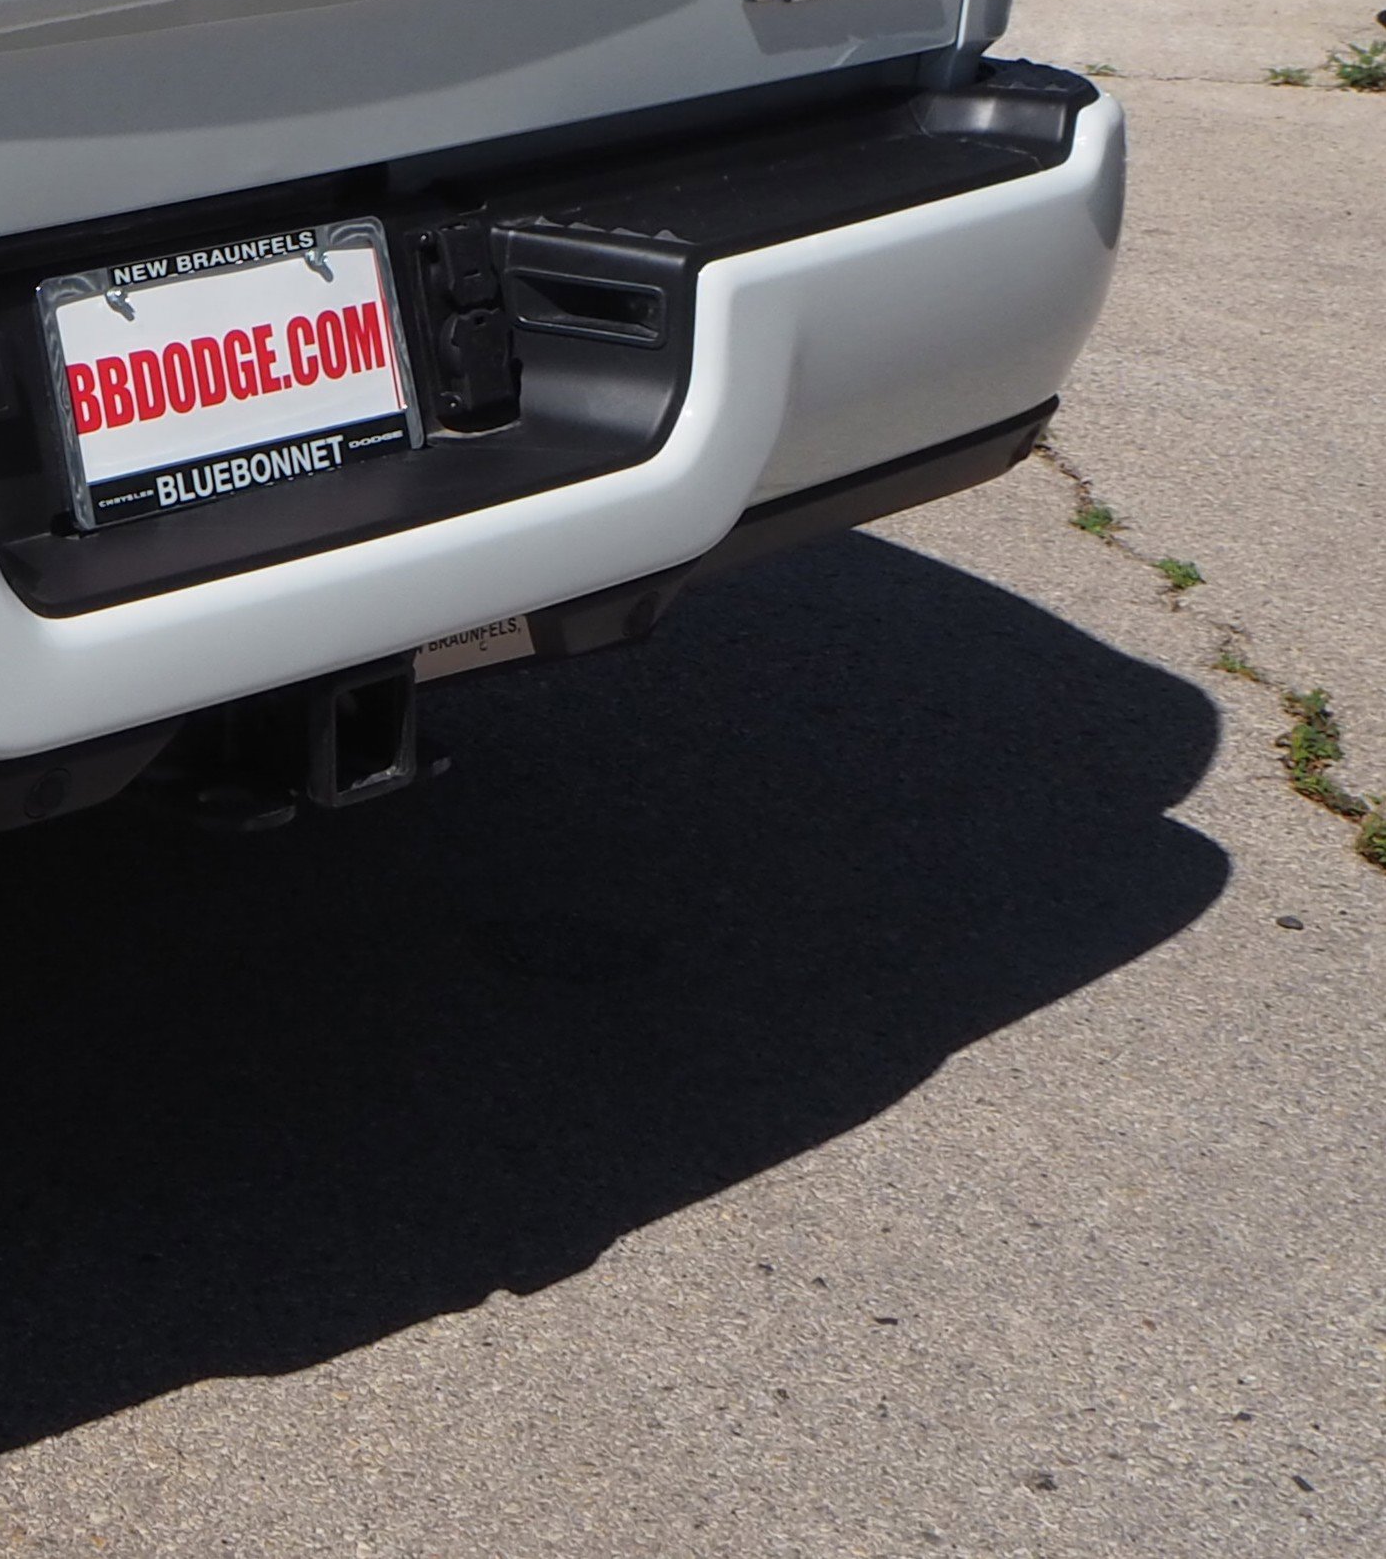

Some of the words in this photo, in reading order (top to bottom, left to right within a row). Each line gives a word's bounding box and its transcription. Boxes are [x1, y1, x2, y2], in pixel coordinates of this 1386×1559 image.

[113, 260, 169, 285] NEW
[176, 231, 315, 272] BRAUNFELS
[65, 301, 386, 435] BBDODGE.COM
[155, 434, 344, 507] BLUEBONNET
[348, 429, 404, 449] DODGE
